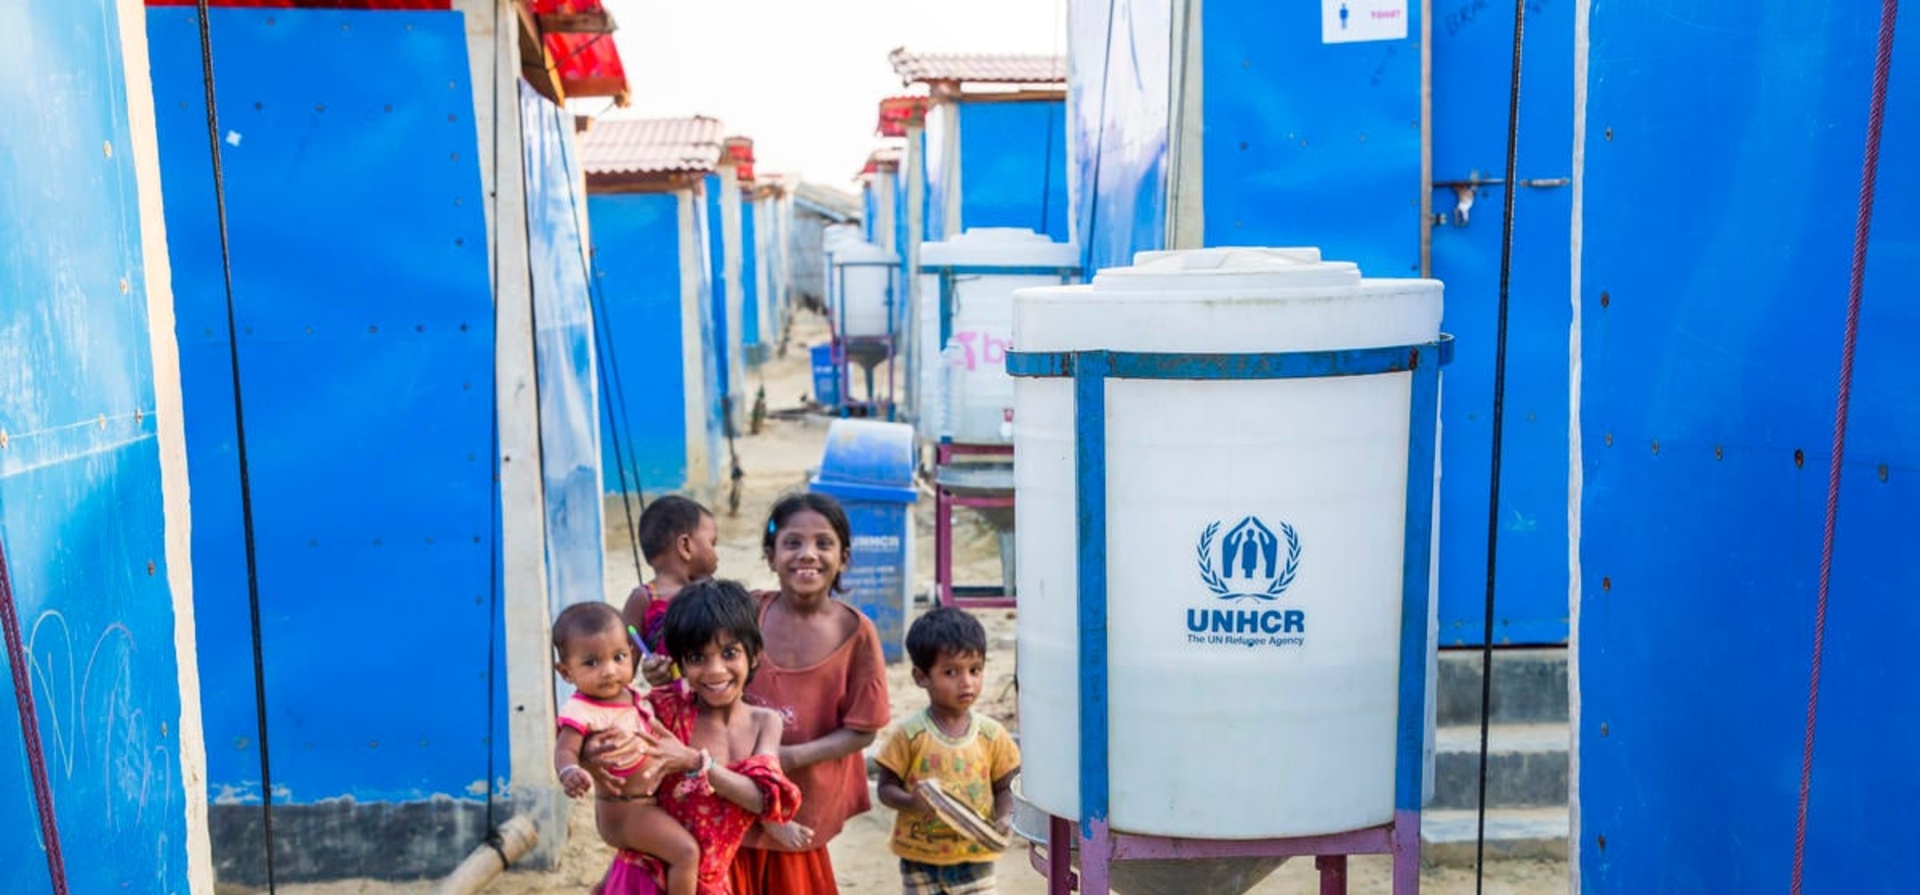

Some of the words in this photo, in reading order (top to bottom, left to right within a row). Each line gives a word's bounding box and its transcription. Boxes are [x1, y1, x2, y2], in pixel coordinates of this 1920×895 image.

[1187, 608, 1305, 634] UNHCR
[1188, 634, 1206, 644] The
[1208, 635, 1223, 644] UN
[1225, 636, 1266, 647] Refugee
[1269, 636, 1305, 647] Agency
